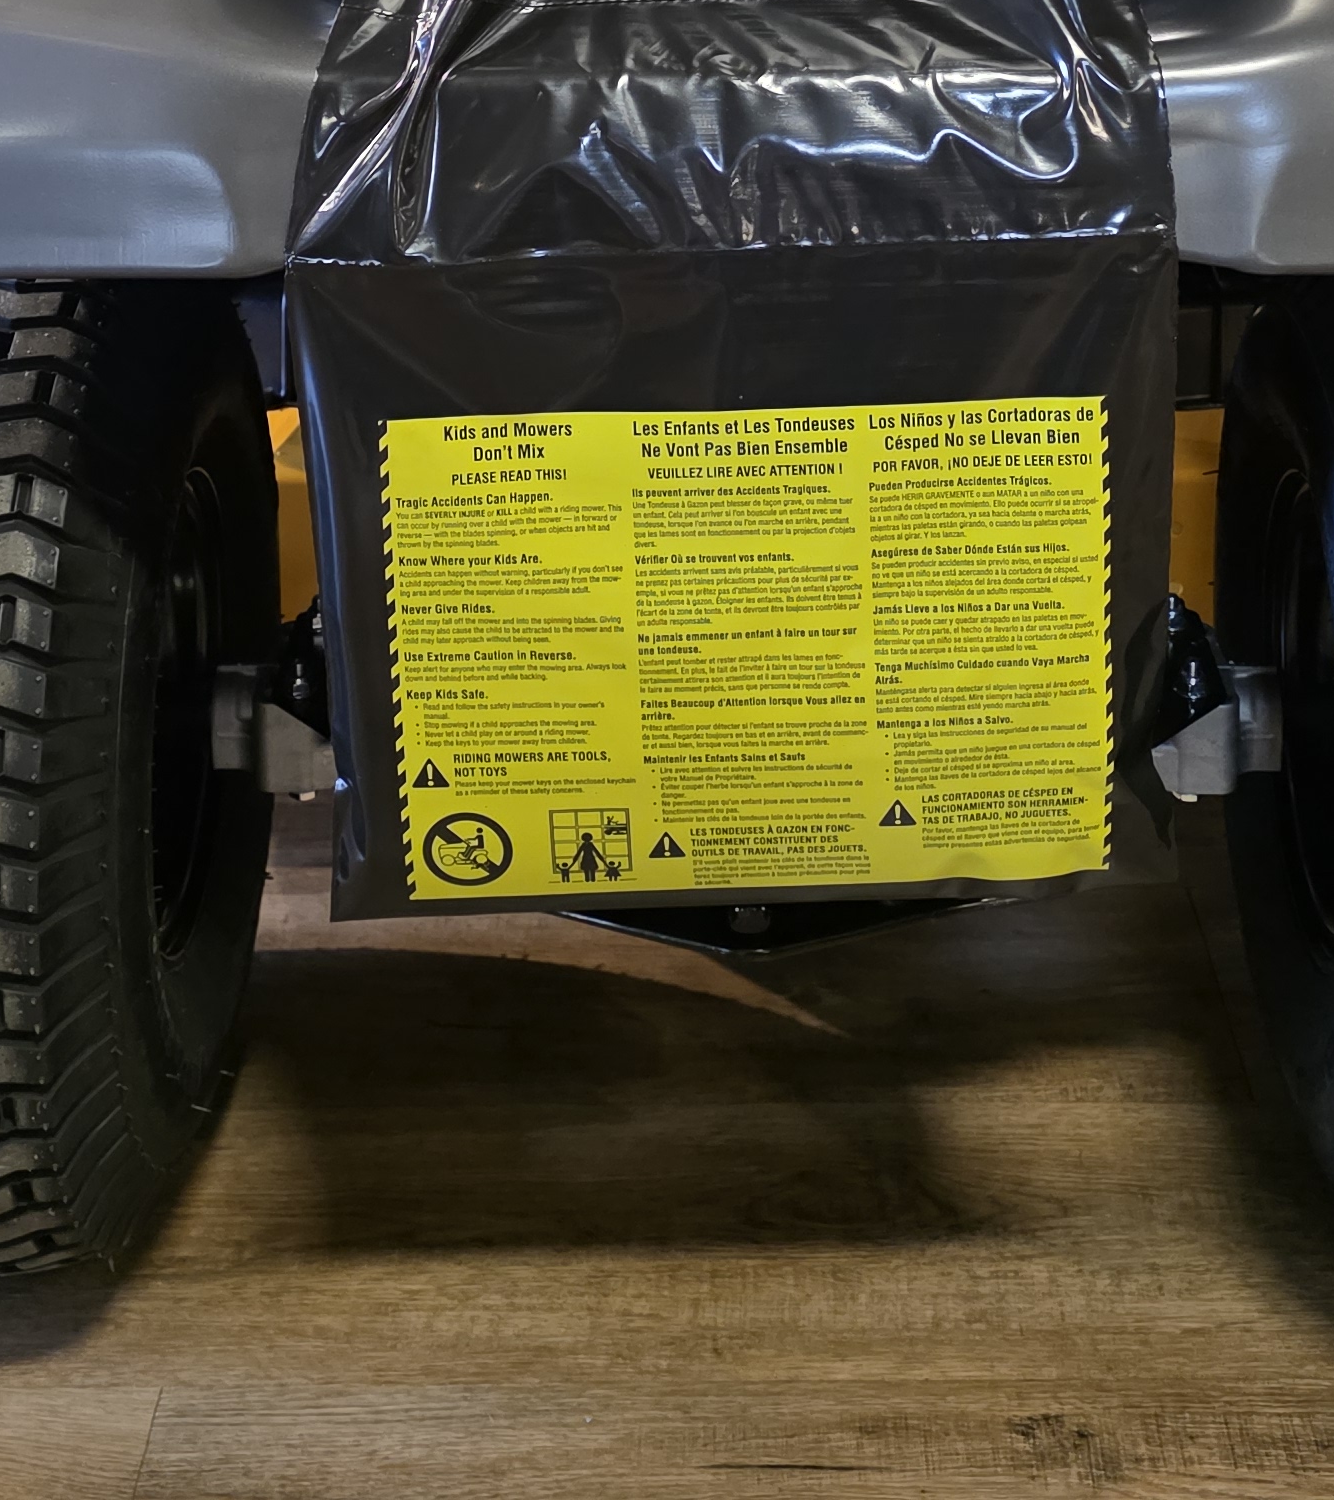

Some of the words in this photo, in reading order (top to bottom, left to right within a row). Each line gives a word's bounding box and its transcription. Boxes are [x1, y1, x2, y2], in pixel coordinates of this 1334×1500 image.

[868, 414, 895, 430] Los
[900, 412, 943, 428] Niños
[946, 415, 955, 430] y
[960, 410, 982, 426] las
[987, 407, 1071, 425] Cortadoras
[1076, 406, 1093, 421] de
[443, 425, 476, 441] Kids
[481, 424, 507, 440] and
[513, 422, 572, 439] Mowers
[632, 421, 659, 436] Les
[663, 420, 719, 435] Enfants
[724, 419, 739, 434] et
[743, 419, 770, 433] Les
[773, 417, 855, 432] Tondeuses
[641, 442, 660, 457] Ne
[665, 441, 699, 457] Vont
[704, 441, 731, 456] Pas
[736, 440, 769, 455] Bien
[774, 438, 848, 454] Ensemble
[884, 434, 939, 454] Césped
[944, 433, 964, 448] No
[968, 436, 986, 447] se
[991, 430, 1041, 446] Llevan
[1046, 429, 1080, 444] Bien
[473, 445, 513, 461] Don't
[517, 444, 545, 460] Mix
[647, 466, 703, 479] VEUILLEZ
[706, 465, 733, 478] LIRE
[735, 465, 766, 477] AVEC
[768, 463, 835, 476] ATTENTION
[838, 463, 842, 474] !
[872, 460, 897, 472] POR
[900, 459, 943, 474] FAVOR,
[947, 458, 968, 472] ¡NO
[972, 457, 1002, 469] DEJE
[1004, 456, 1021, 468] DE
[1023, 455, 1054, 467] LEER
[1057, 453, 1092, 466] ESTO!
[451, 472, 496, 486] PLEASE
[499, 470, 531, 483] READ
[534, 469, 567, 481] THIS!
[868, 481, 903, 492] Pueden
[904, 479, 954, 490] Producirse
[956, 477, 1007, 489] Accidentes
[1008, 476, 1052, 489] Trágicos.
[631, 488, 643, 497] Ils
[645, 487, 682, 499] peuvent
[683, 487, 715, 496] arriver
[717, 486, 734, 496] des
[735, 485, 780, 495] Accidents
[782, 484, 831, 496] Tragiques.
[395, 496, 428, 511] Tragic
[430, 494, 483, 507] Accidents
[485, 493, 506, 504] Can
[509, 491, 553, 506] Happen.
[424, 510, 457, 519] SEVERLY
[458, 509, 485, 518] INJURE
[495, 508, 512, 517] KILL
[634, 555, 668, 564] Vérifier
[670, 554, 683, 564] Où
[698, 553, 736, 563] trouvent
[756, 552, 794, 562] enfants.
[870, 548, 918, 560] Asegúrese
[921, 547, 932, 557] de
[934, 546, 962, 556] Saber
[964, 545, 993, 555] Dónde
[996, 544, 1022, 554] Están
[1042, 543, 1069, 555] Hijos.
[398, 555, 427, 566] Know
[429, 555, 465, 566] Where
[467, 556, 491, 567] your
[494, 554, 517, 565] Kids
[519, 553, 542, 564] Are.
[400, 604, 432, 615] Never
[434, 604, 458, 614] Give
[461, 603, 495, 614] Rides.
[403, 652, 424, 662] Use
[426, 651, 470, 662] Extreme
[473, 651, 514, 661] Caution
[516, 651, 527, 661] in
[529, 650, 576, 661] Reverse.
[874, 662, 902, 674] Tenga
[904, 659, 954, 670] Muchísimo
[956, 658, 994, 668] Cuidado
[995, 656, 1029, 666] cuando
[1031, 655, 1054, 667] Vaya
[1056, 653, 1089, 664] Marcha
[874, 675, 903, 685] Atrás.
[406, 689, 432, 702] Keep
[435, 689, 458, 699] Kids
[460, 689, 488, 699] Safe.
[452, 753, 491, 764] RIDING
[494, 752, 544, 763] MOWERS
[546, 751, 568, 762] ARE
[570, 751, 611, 764] TOOLS,
[643, 754, 686, 764] Maintenir
[688, 754, 702, 763] les
[704, 754, 738, 763] Enfants
[740, 753, 766, 762] Sains
[768, 753, 778, 762] et
[779, 752, 805, 762] Saufs
[453, 767, 476, 777] NOT
[478, 767, 507, 777] TOYS
[921, 794, 939, 804] LAS
[941, 791, 1005, 803] CORTADORAS
[1007, 790, 1020, 799] DE
[1022, 786, 1058, 798] CÉSPED
[1060, 787, 1073, 796] EN
[921, 801, 1005, 814] FUNCIONAMIENTO
[1007, 800, 1027, 810] SON
[1029, 796, 1088, 809] HERRAMIEN-
[921, 816, 940, 825] TAS
[941, 815, 954, 824] DE
[956, 812, 1002, 825] TRABAJO,
[1004, 811, 1018, 820] NO
[1020, 809, 1071, 819] JUGUETES.
[689, 827, 707, 836] LES
[709, 826, 765, 836] TONDEUSES
[766, 825, 774, 834] À
[775, 825, 808, 834] GAZON
[810, 825, 823, 833] EN
[825, 824, 855, 833] FONC-
[690, 837, 750, 847] TIONNEMENT
[752, 835, 817, 845] CONSTITUENT
[819, 835, 839, 844] DES
[691, 848, 725, 857] OUTILS
[727, 848, 740, 856] DE
[741, 847, 784, 857] TRAVAIL,
[786, 846, 804, 854] PAS
[806, 846, 825, 854] DES
[827, 845, 867, 853] JOUETS.
